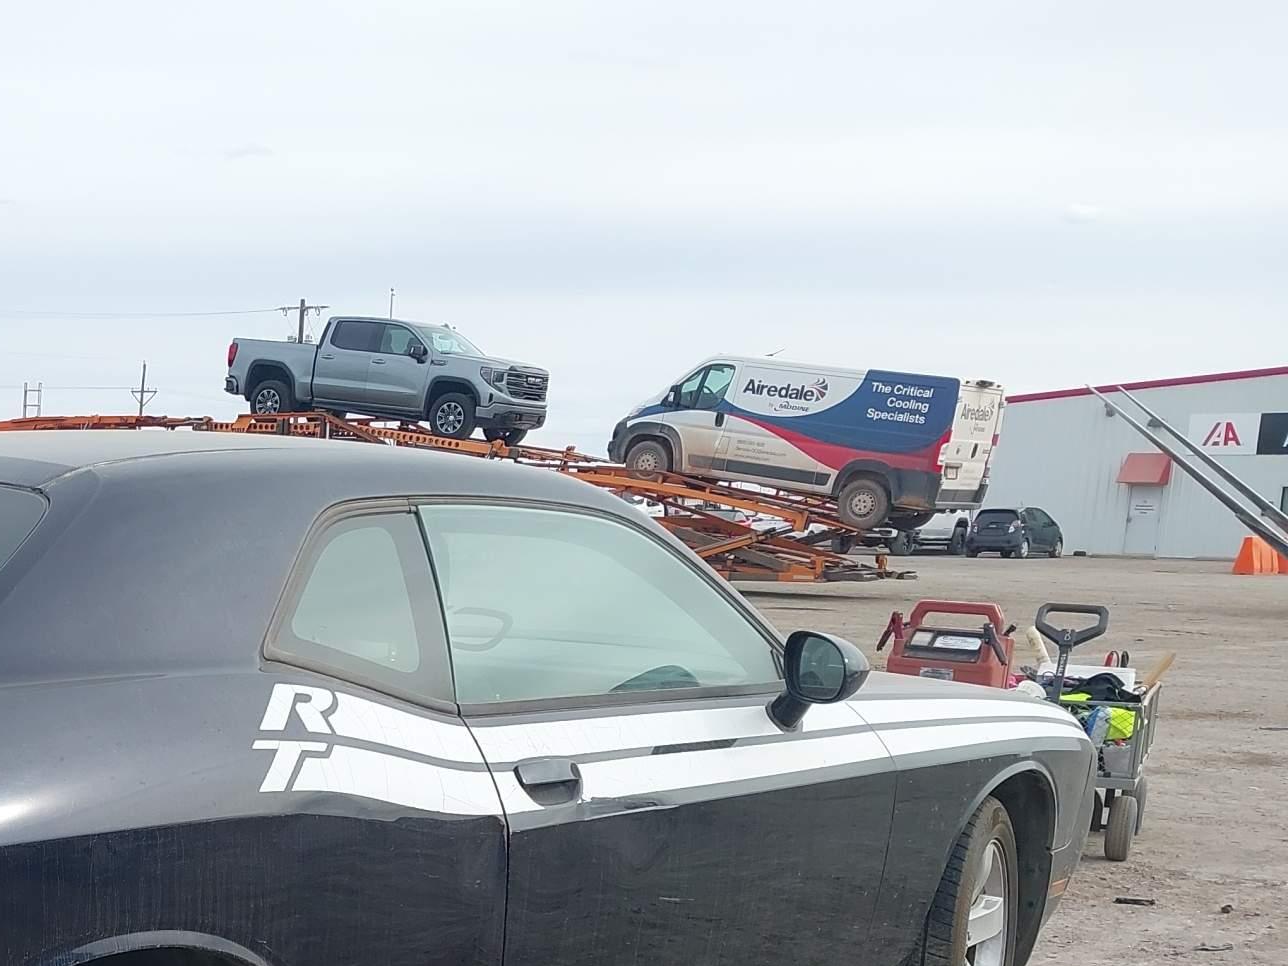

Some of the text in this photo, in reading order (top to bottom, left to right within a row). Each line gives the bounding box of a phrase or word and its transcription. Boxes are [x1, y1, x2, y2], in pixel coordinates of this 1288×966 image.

[743, 378, 815, 402] Airedale
[872, 382, 934, 398] The Critical
[886, 397, 930, 413] Cooling
[960, 403, 992, 421] Airedale
[866, 408, 926, 425] Specialists
